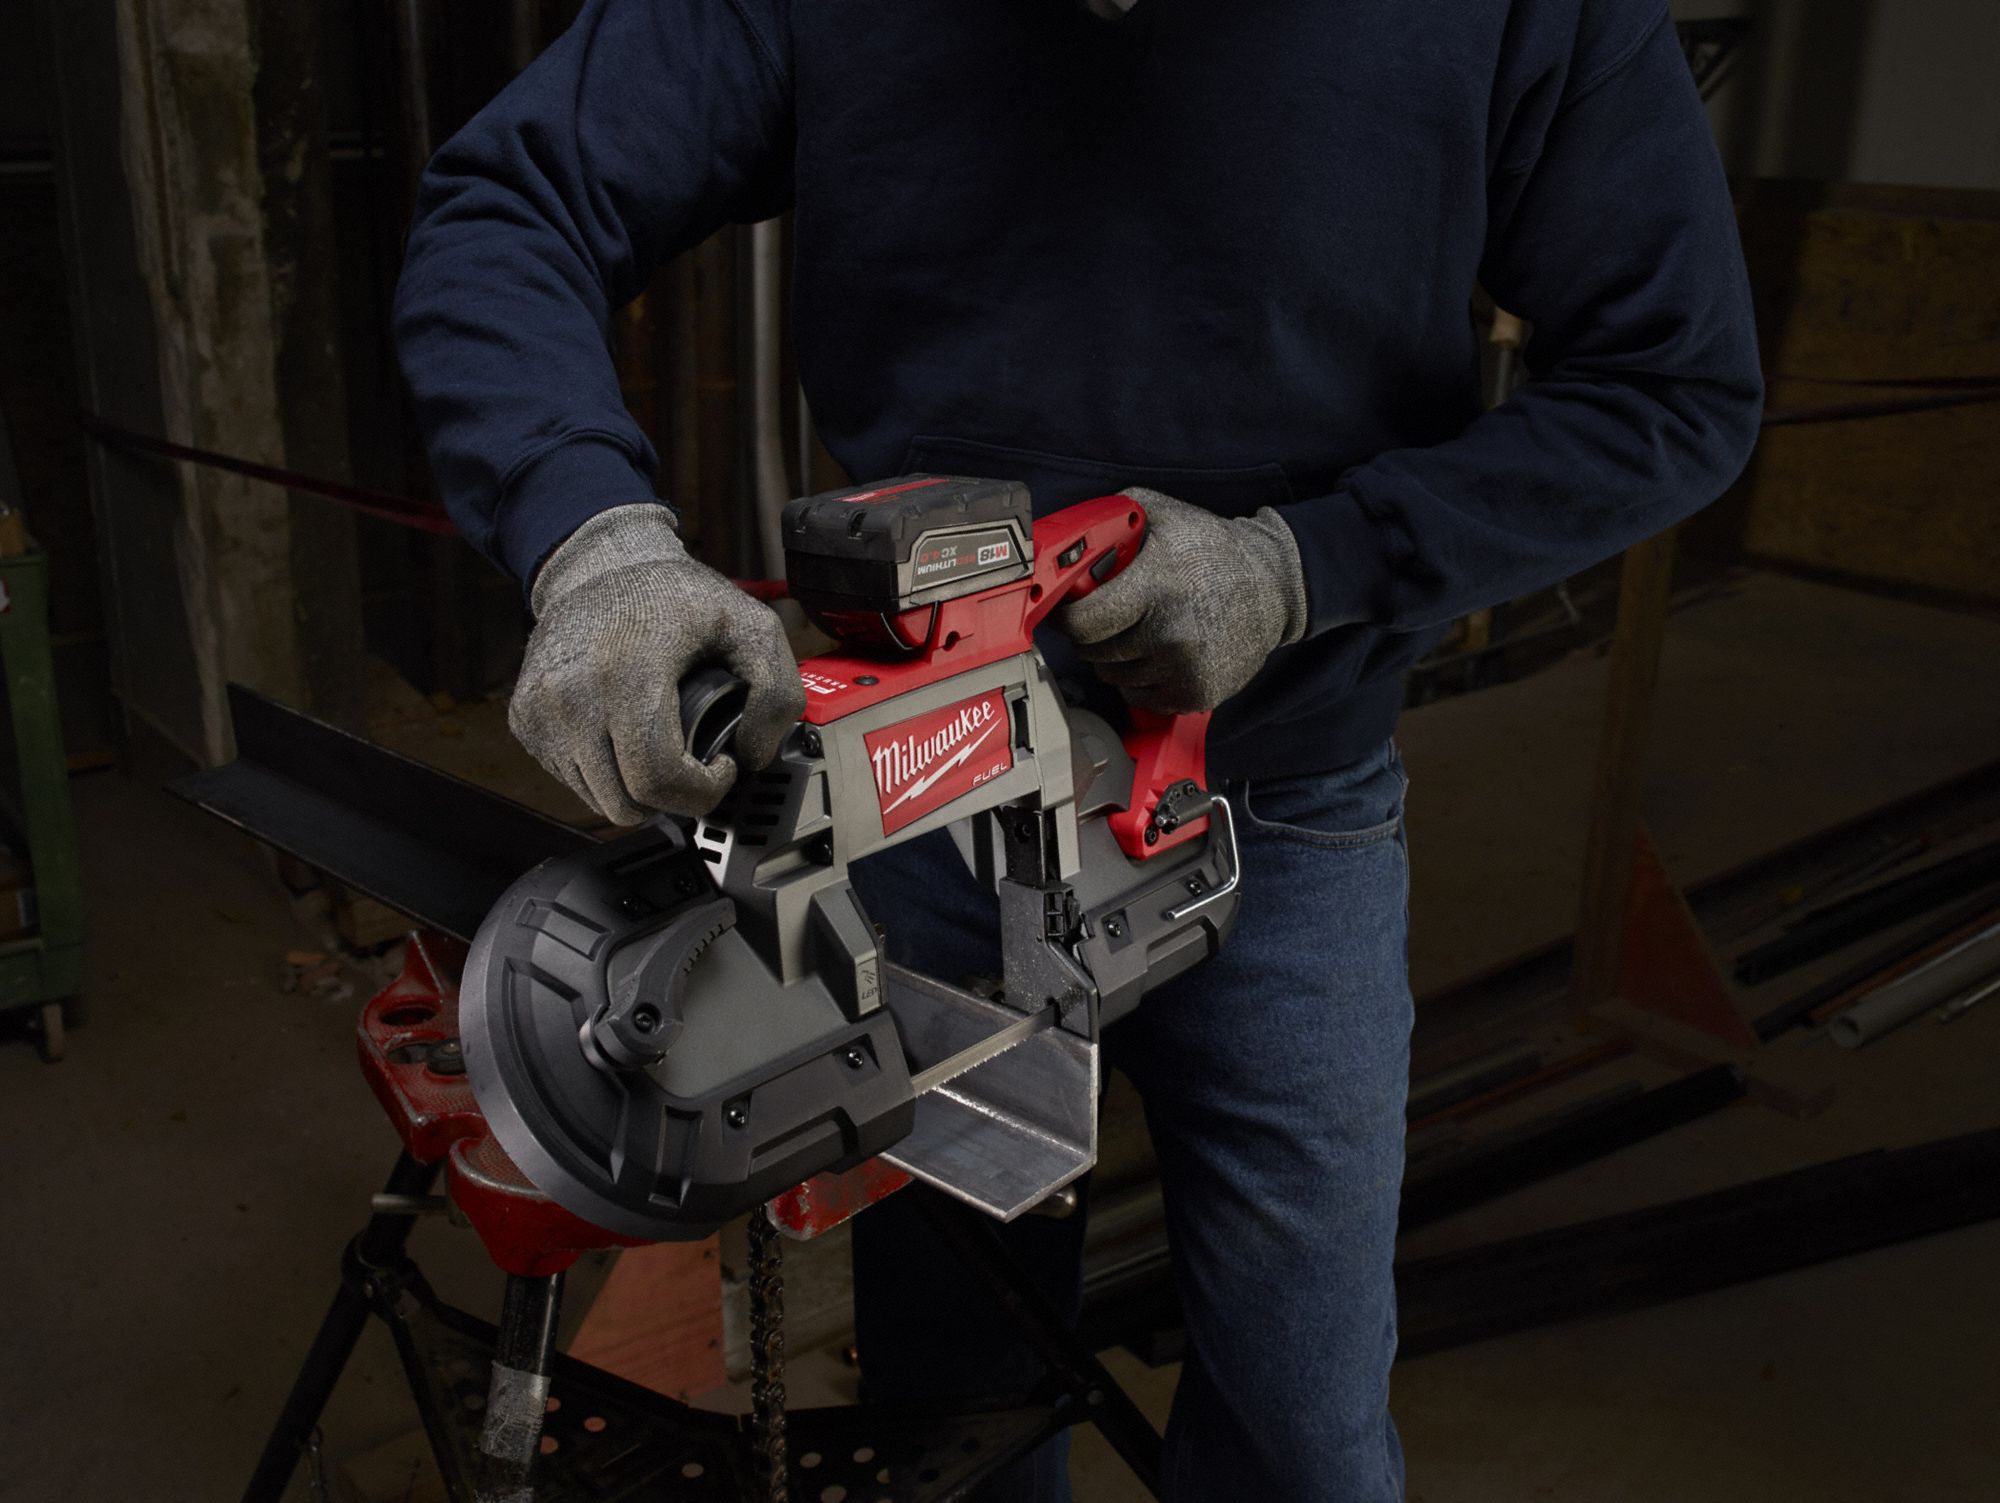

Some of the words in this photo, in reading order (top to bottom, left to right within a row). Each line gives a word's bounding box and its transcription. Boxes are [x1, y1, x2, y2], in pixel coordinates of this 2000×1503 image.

[979, 544, 1007, 562] M18
[872, 701, 995, 795] Milwaukee
[971, 762, 1008, 787] FUEL
